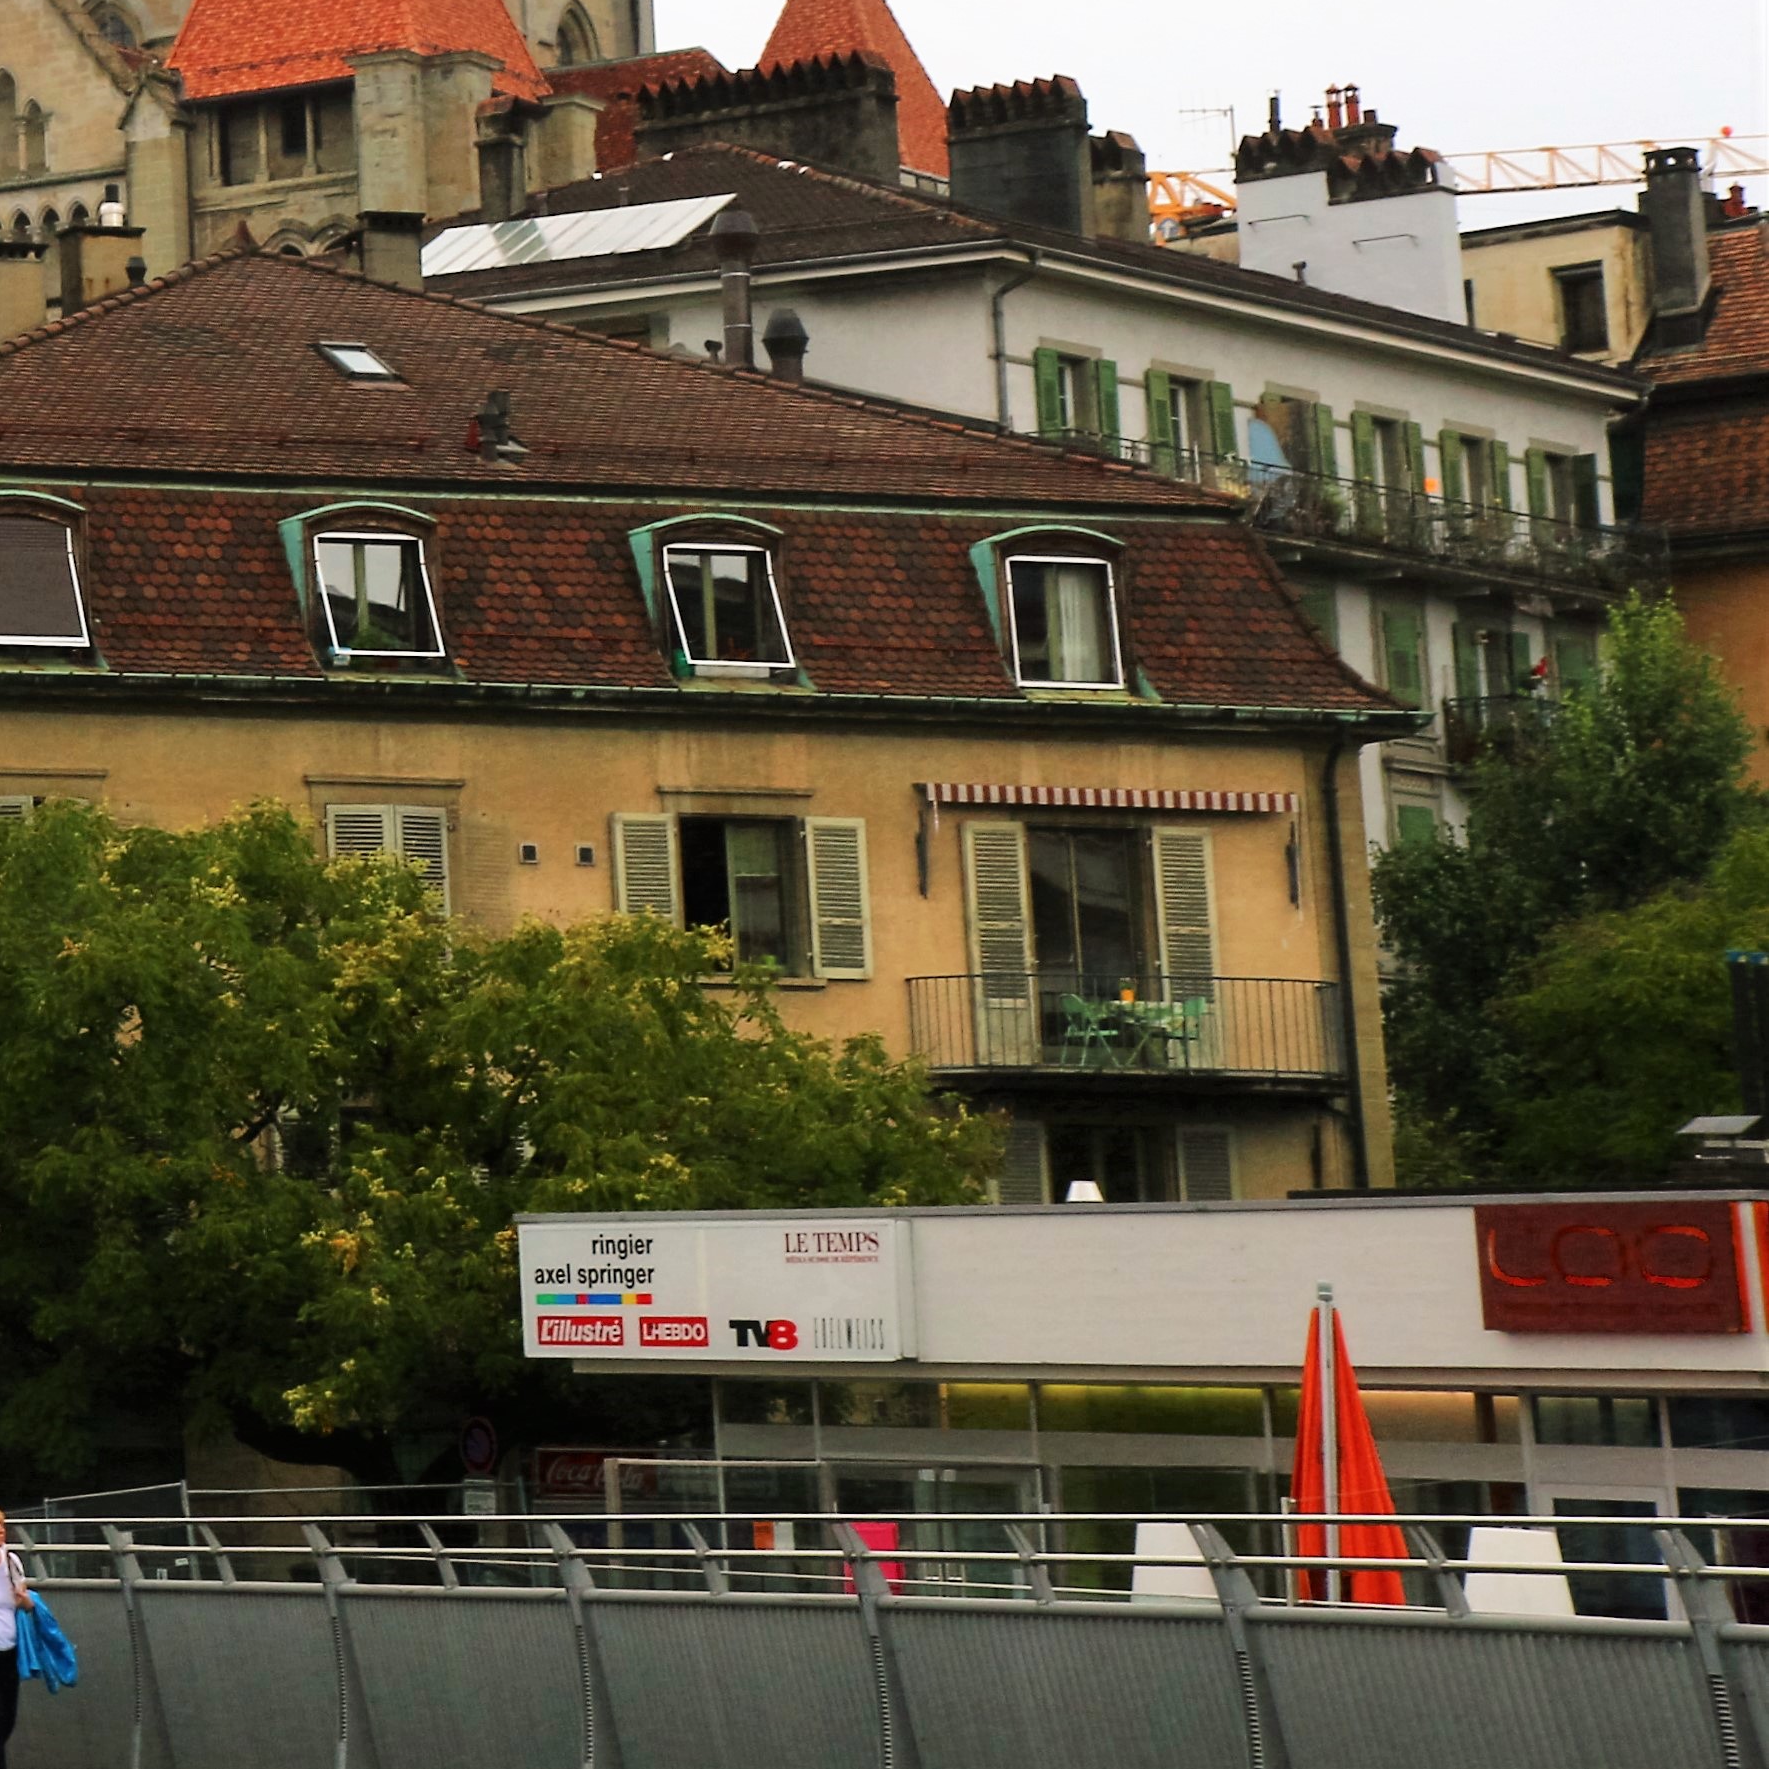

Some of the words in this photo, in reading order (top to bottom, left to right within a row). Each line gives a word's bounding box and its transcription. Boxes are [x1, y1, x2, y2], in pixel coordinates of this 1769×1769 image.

[592, 1233, 654, 1260] ringier
[785, 1232, 809, 1253] LE
[812, 1231, 880, 1253] TEMPS
[534, 1263, 572, 1285] axel
[577, 1262, 655, 1289] springer
[540, 1318, 622, 1343] L'illustré
[728, 1318, 799, 1351] TV8
[814, 1317, 885, 1351] EDELWEISS
